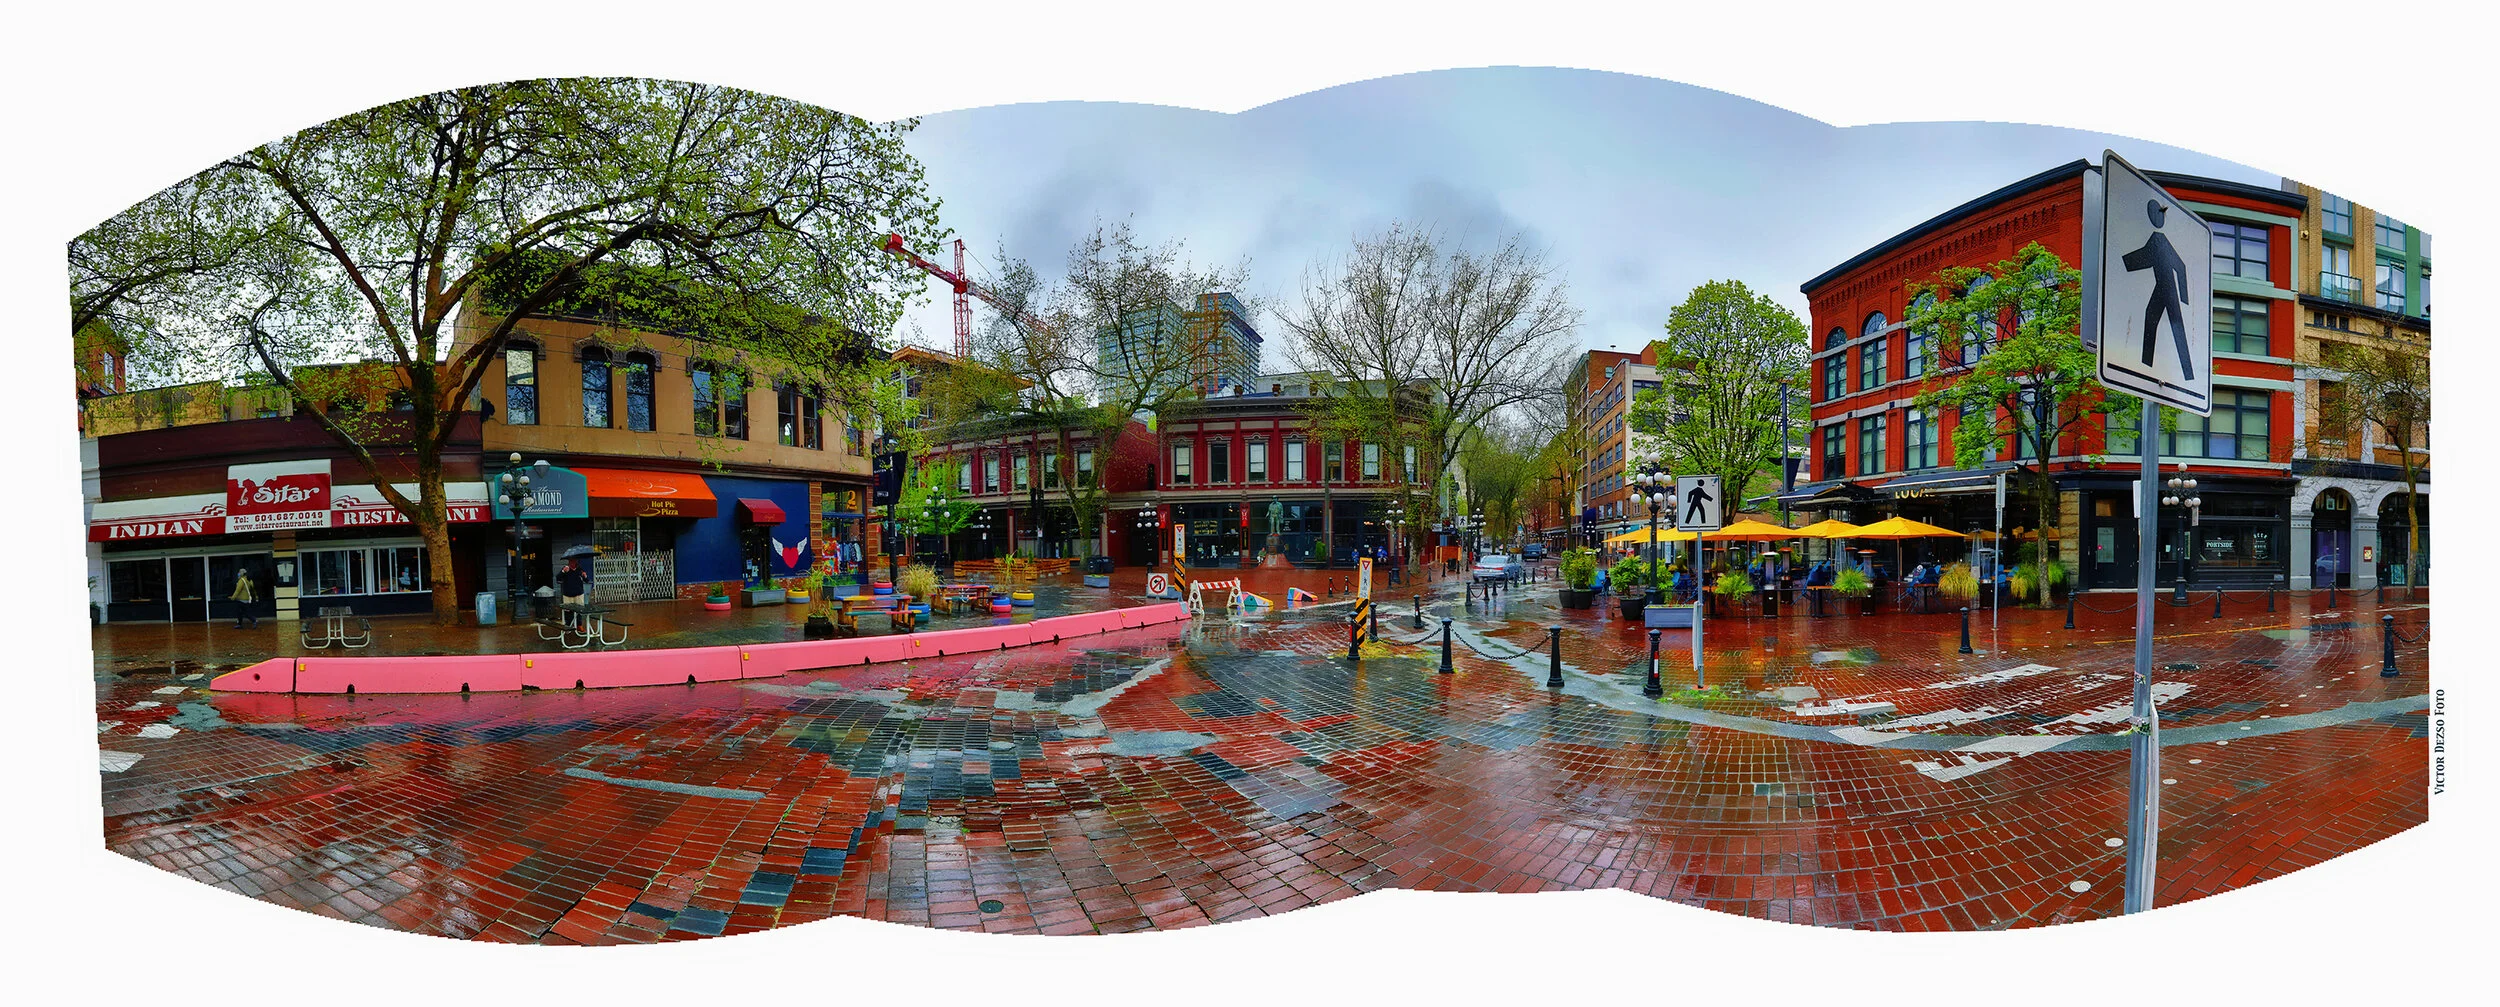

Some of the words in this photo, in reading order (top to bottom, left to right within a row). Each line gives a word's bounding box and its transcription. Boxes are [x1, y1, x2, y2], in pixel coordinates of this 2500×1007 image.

[253, 484, 320, 504] Sitar
[523, 492, 562, 506] AMOND
[343, 507, 479, 526] RESTANT
[661, 508, 679, 516] Pizza
[233, 516, 249, 524] Tel:
[233, 519, 324, 531] www.sitarrestaurant.net
[108, 520, 205, 539] INDIAN
